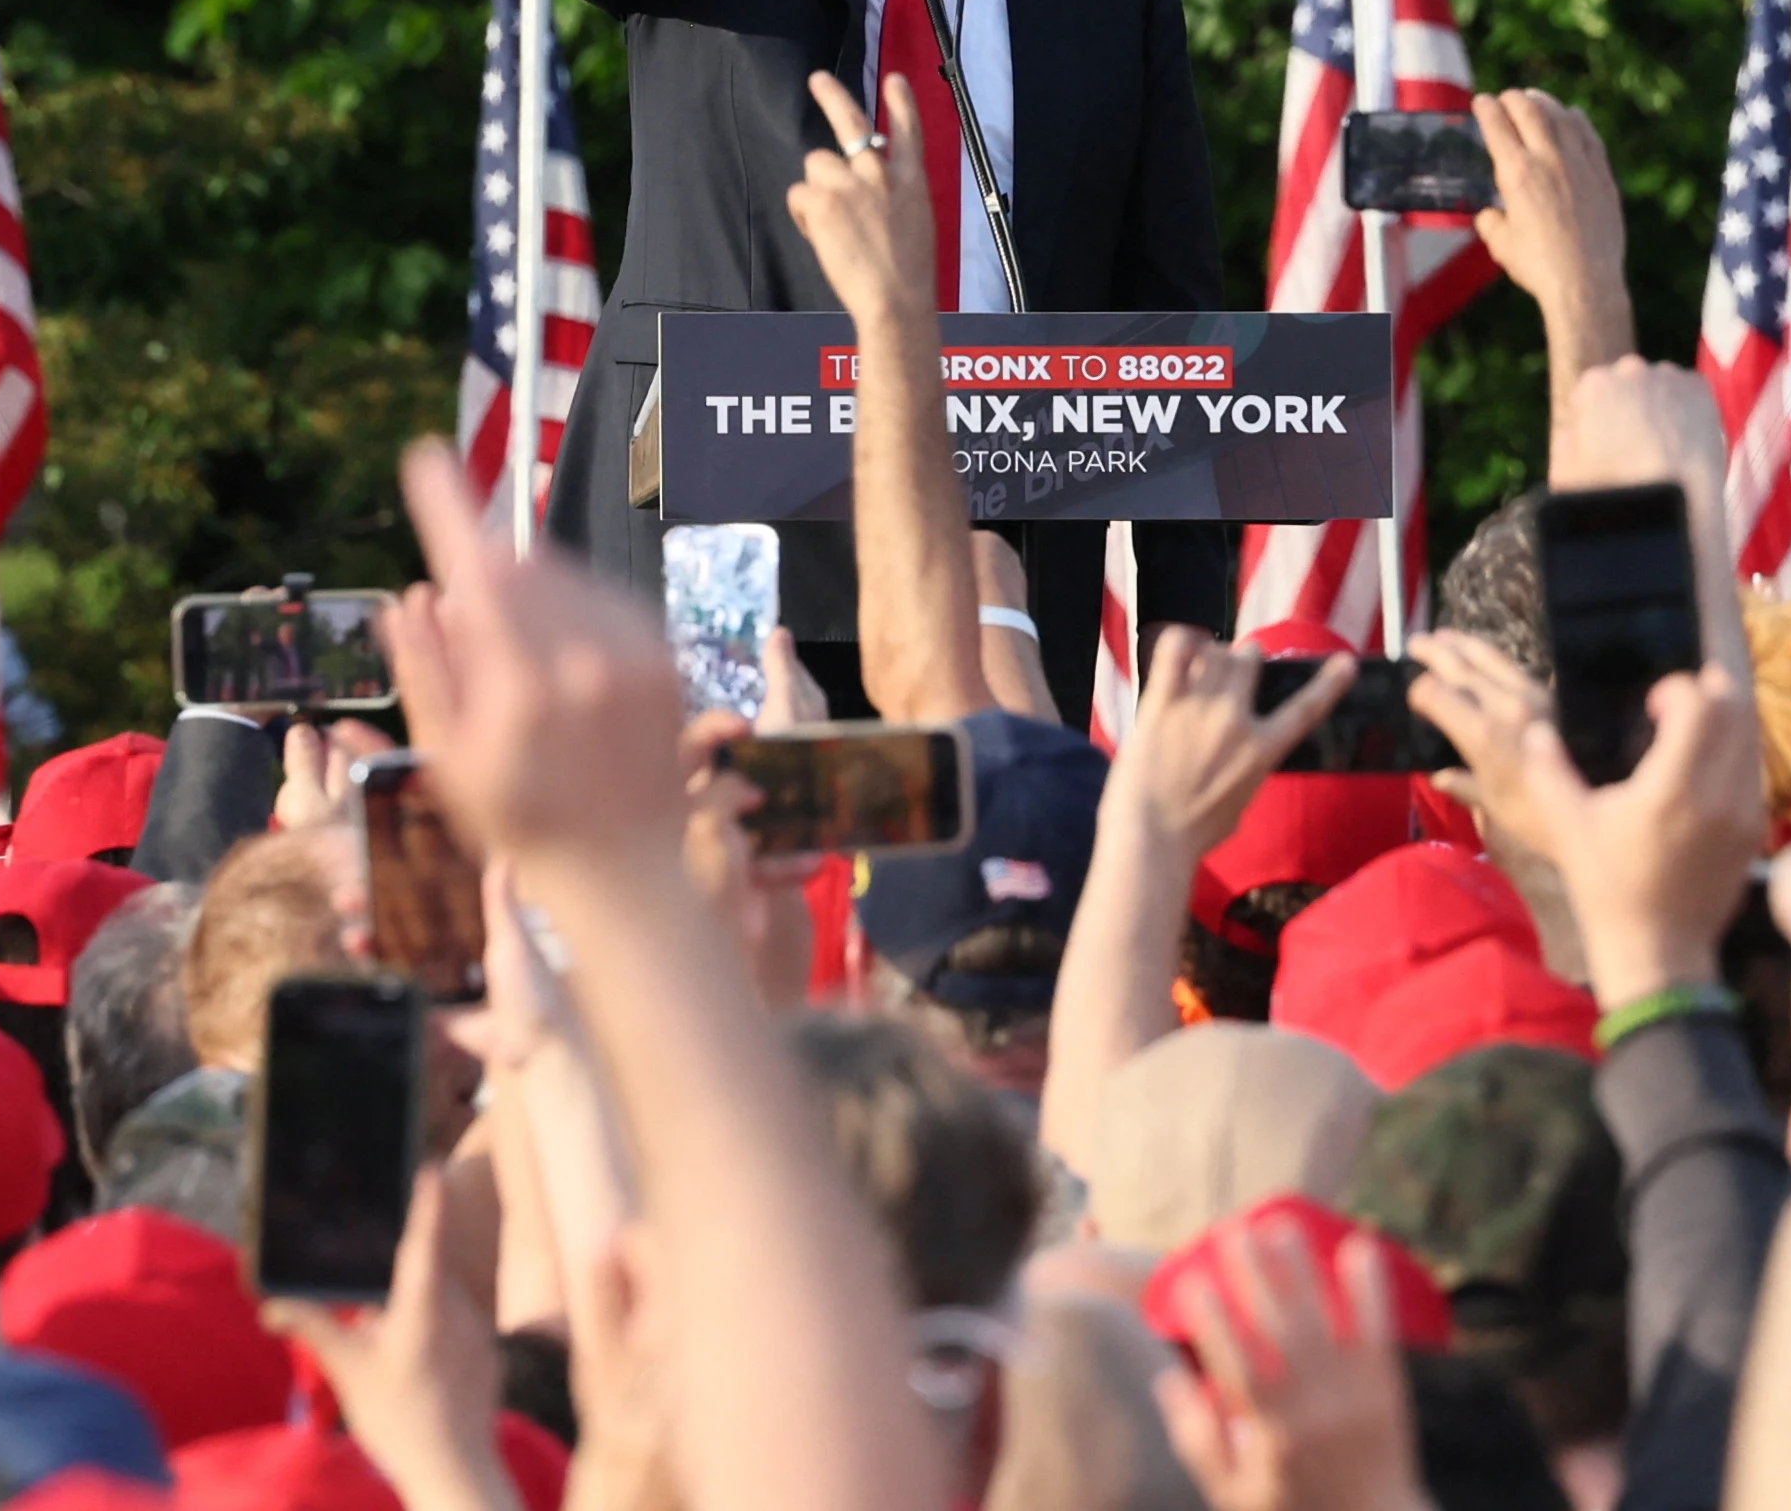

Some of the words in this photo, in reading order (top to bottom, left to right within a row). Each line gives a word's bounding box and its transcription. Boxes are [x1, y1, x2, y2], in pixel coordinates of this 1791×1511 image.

[827, 354, 860, 381] TE
[1061, 355, 1107, 381] TO
[1118, 354, 1225, 381] 88022
[706, 394, 812, 435] THE
[829, 394, 1035, 441] BNX,
[1052, 394, 1181, 434] NEW
[1196, 394, 1347, 434] YORK
[952, 449, 1058, 474] OTONA
[1068, 449, 1148, 474] PARK
[967, 480, 1007, 520] he
